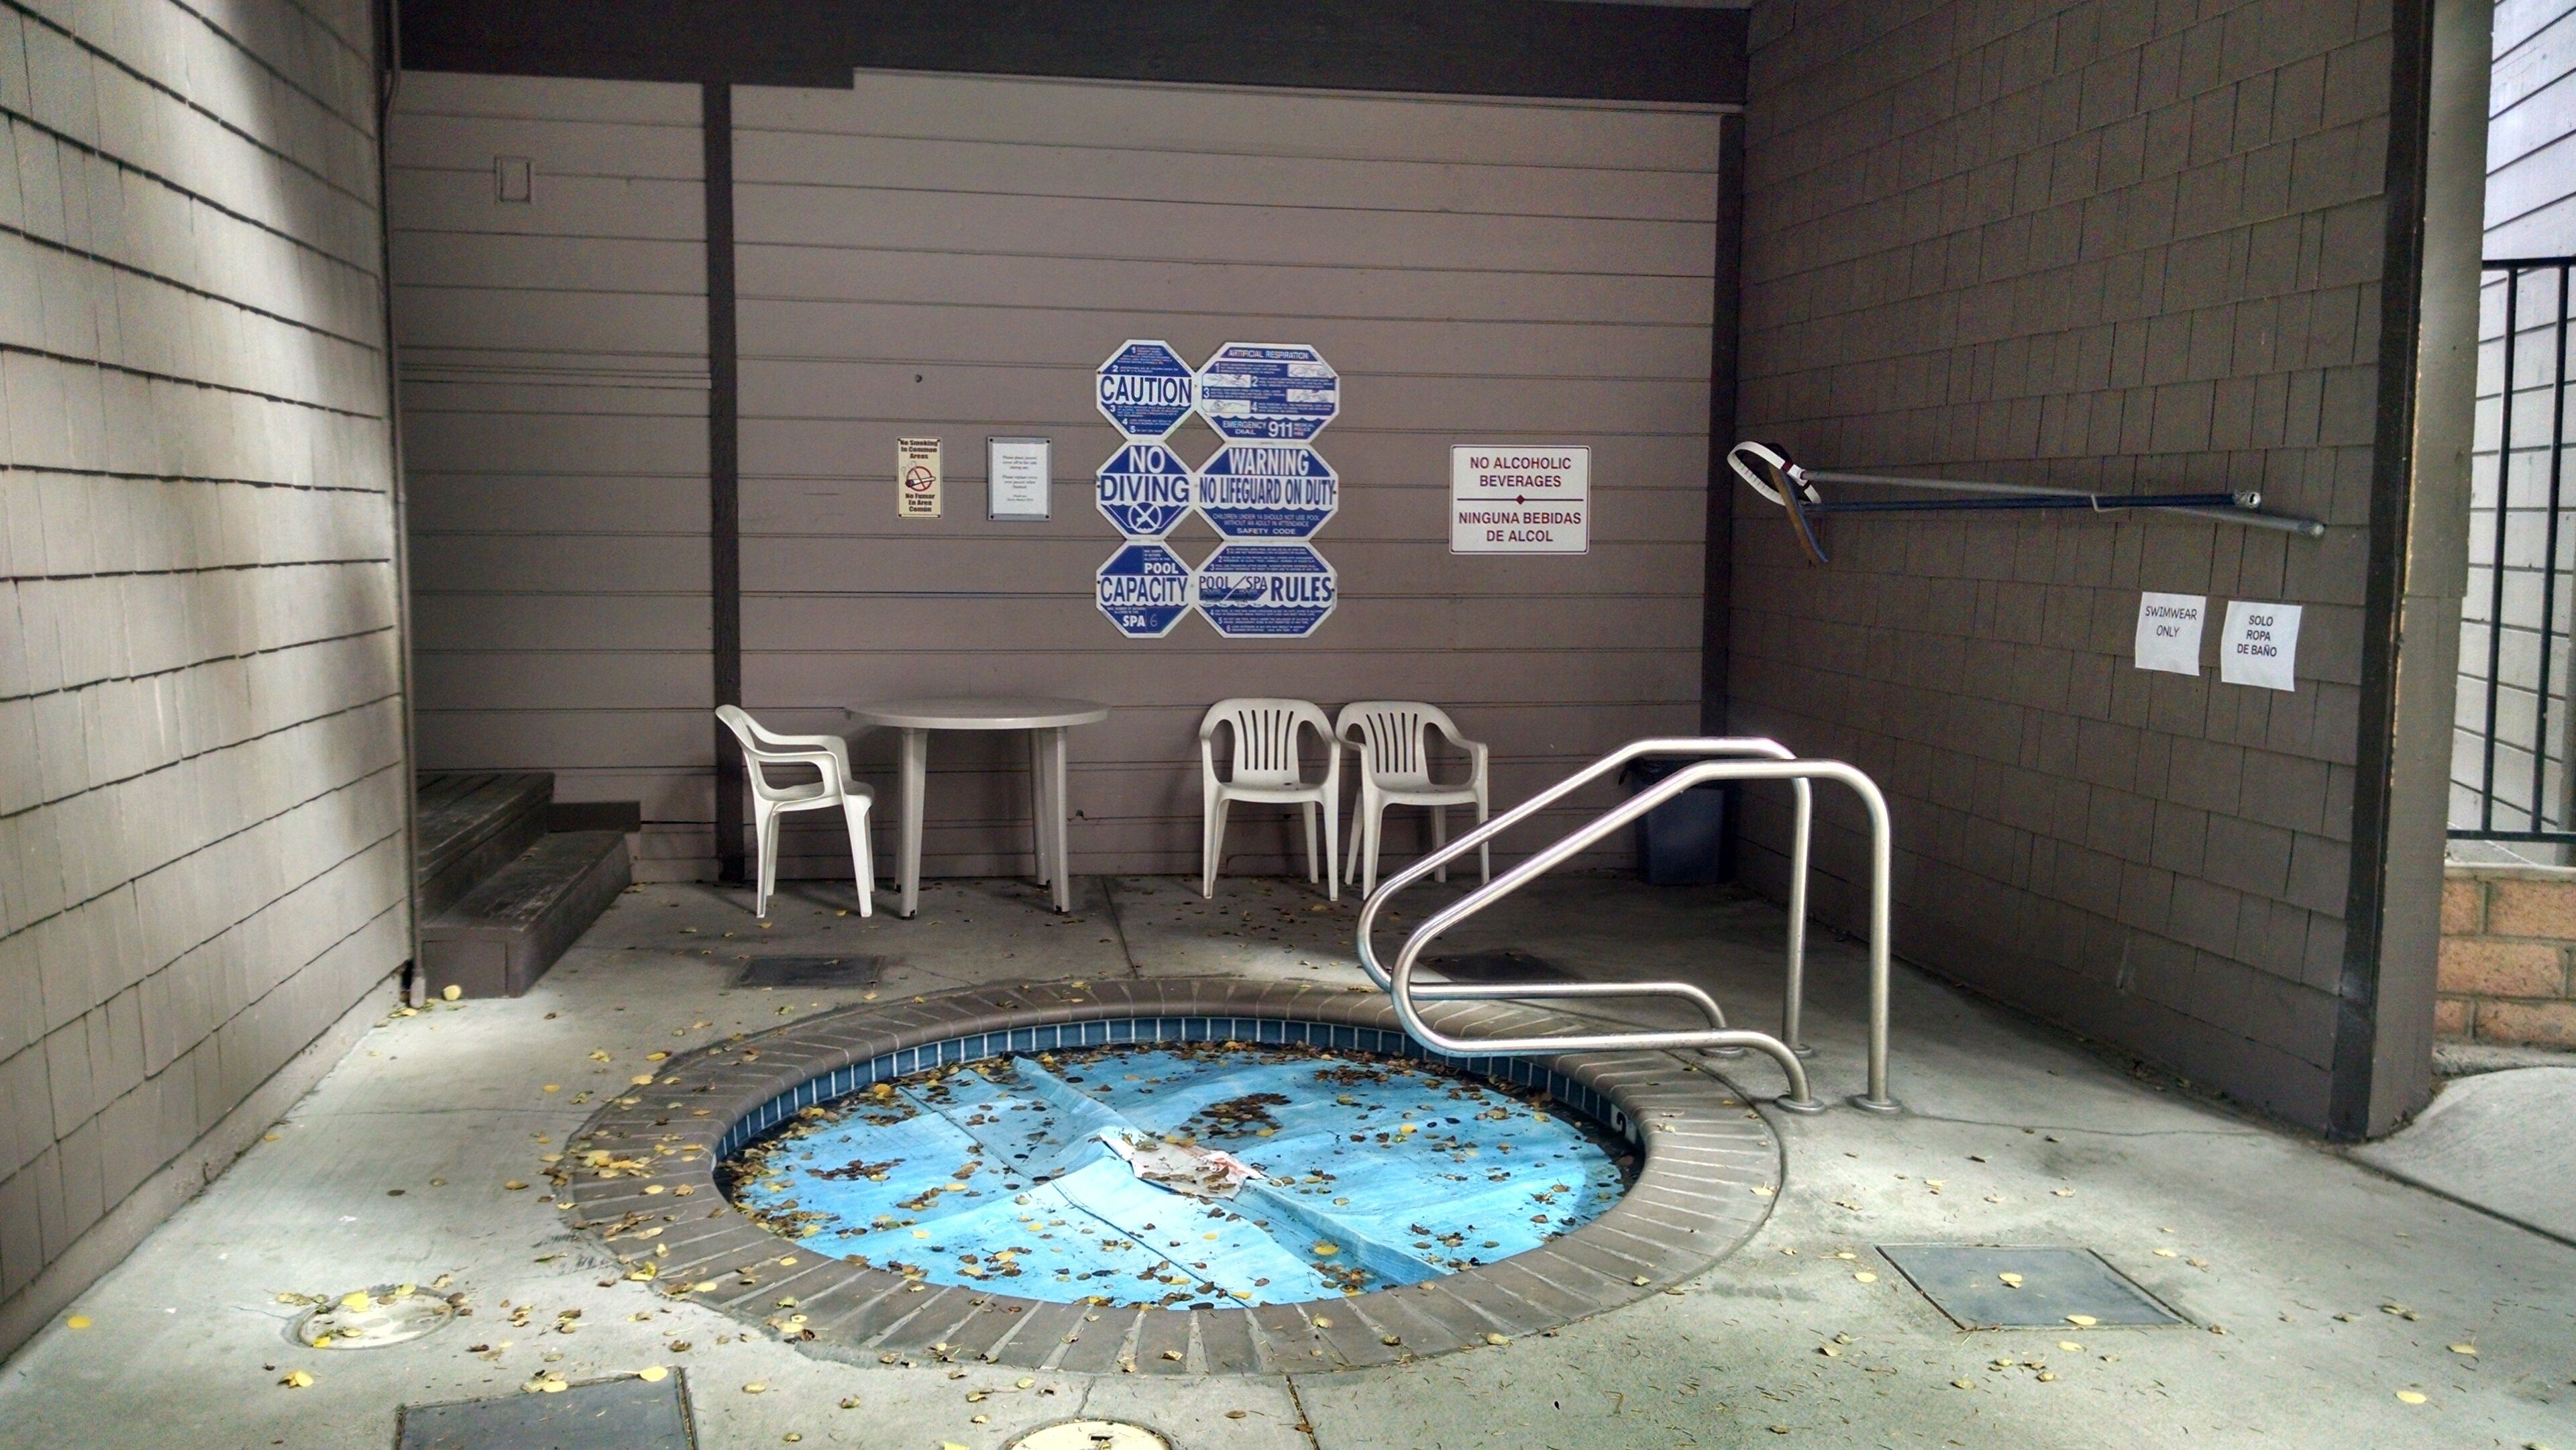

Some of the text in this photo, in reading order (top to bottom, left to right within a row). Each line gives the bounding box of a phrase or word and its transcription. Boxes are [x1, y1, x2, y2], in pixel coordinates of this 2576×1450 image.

[1228, 349, 1309, 360] ARTIFICIAL RESPIRATION
[1251, 376, 1258, 386] 2
[1101, 376, 1192, 403] CAUTION
[1203, 387, 1210, 399] 3
[1251, 402, 1257, 412] 4
[1222, 420, 1267, 429] EMERGENCY
[1268, 421, 1293, 437] 911
[1129, 446, 1165, 474] NO
[1228, 448, 1309, 476] WARNING
[1470, 457, 1572, 469] NO ALCOHOLIC
[1480, 475, 1561, 487] BEVERAGES
[1101, 475, 1189, 503] DIVING
[1199, 477, 1335, 505] NO LIFEGUARD ON DUTY
[1458, 512, 1581, 524] NINGUNA BEBIDAS
[1487, 530, 1553, 542] DE ALCOL
[1144, 562, 1179, 574] POOL
[1101, 576, 1188, 603] CAPACITY
[1199, 576, 1231, 589] POOL
[1246, 576, 1268, 590] SPA
[1271, 576, 1332, 602] RULES
[2146, 606, 2197, 621] SWIMWEAR
[1122, 615, 1146, 627] SPA
[1150, 613, 1158, 627] 6
[2249, 615, 2273, 627] SOLO
[2156, 625, 2180, 637] ONLY
[2246, 629, 2271, 641] ROPA
[2237, 643, 2277, 658] DE BAÑO
